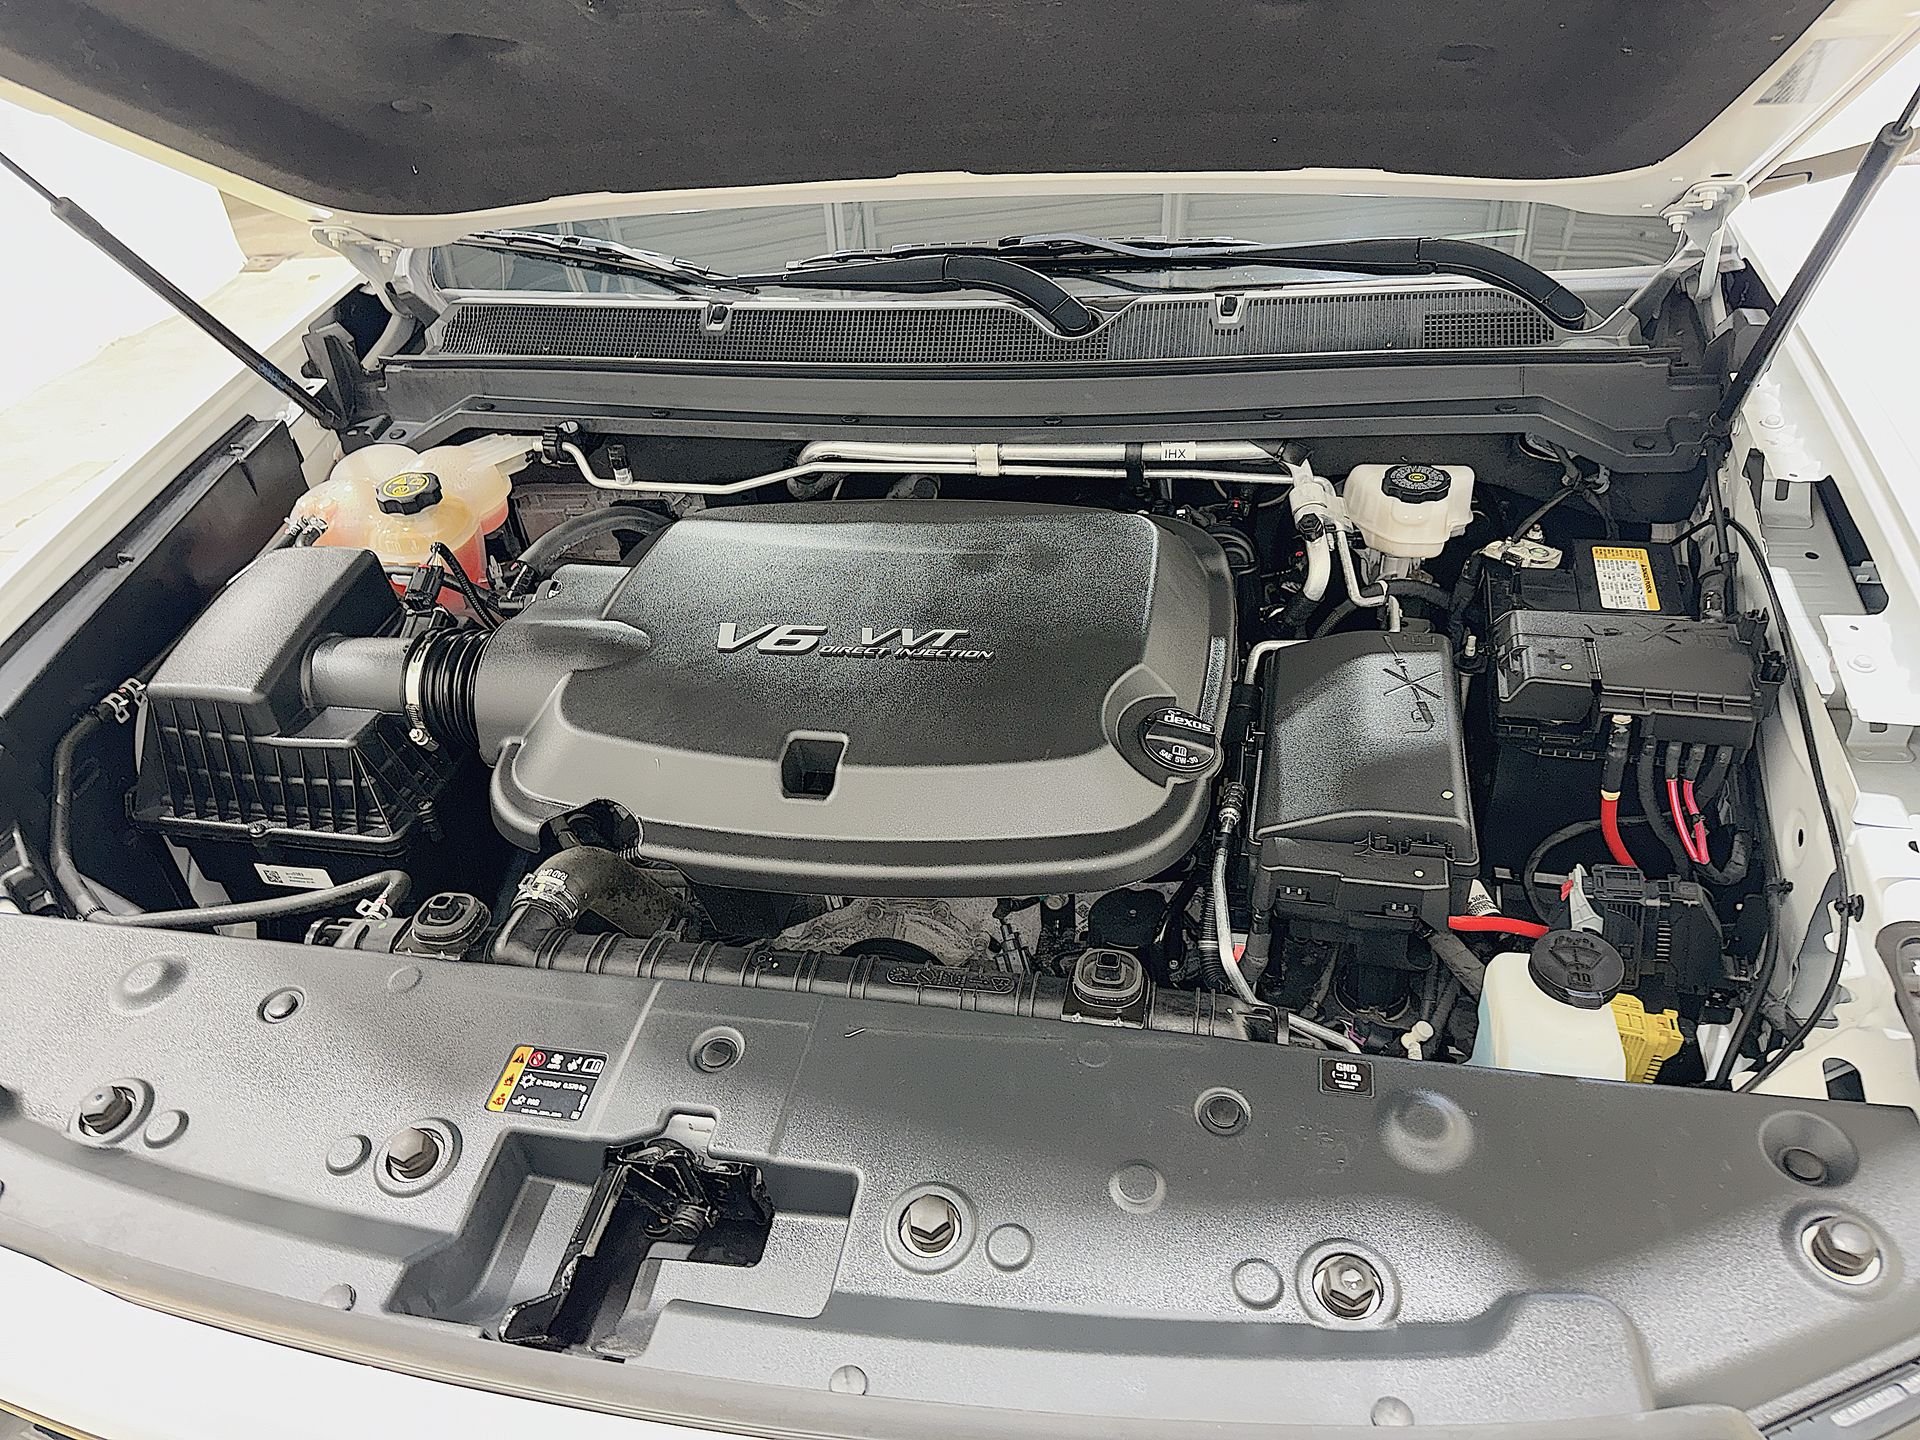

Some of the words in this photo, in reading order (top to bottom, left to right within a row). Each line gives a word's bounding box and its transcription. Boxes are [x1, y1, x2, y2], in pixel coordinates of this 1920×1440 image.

[1165, 449, 1186, 458] IHX
[717, 622, 828, 654] V6
[861, 627, 970, 648] VVT
[819, 645, 891, 658] DIRECT
[894, 647, 995, 660] INJECTION
[1164, 713, 1211, 732] dexos
[1159, 749, 1173, 760] SAE
[1175, 756, 1198, 764] 5W-30
[1336, 1063, 1357, 1073] GND
